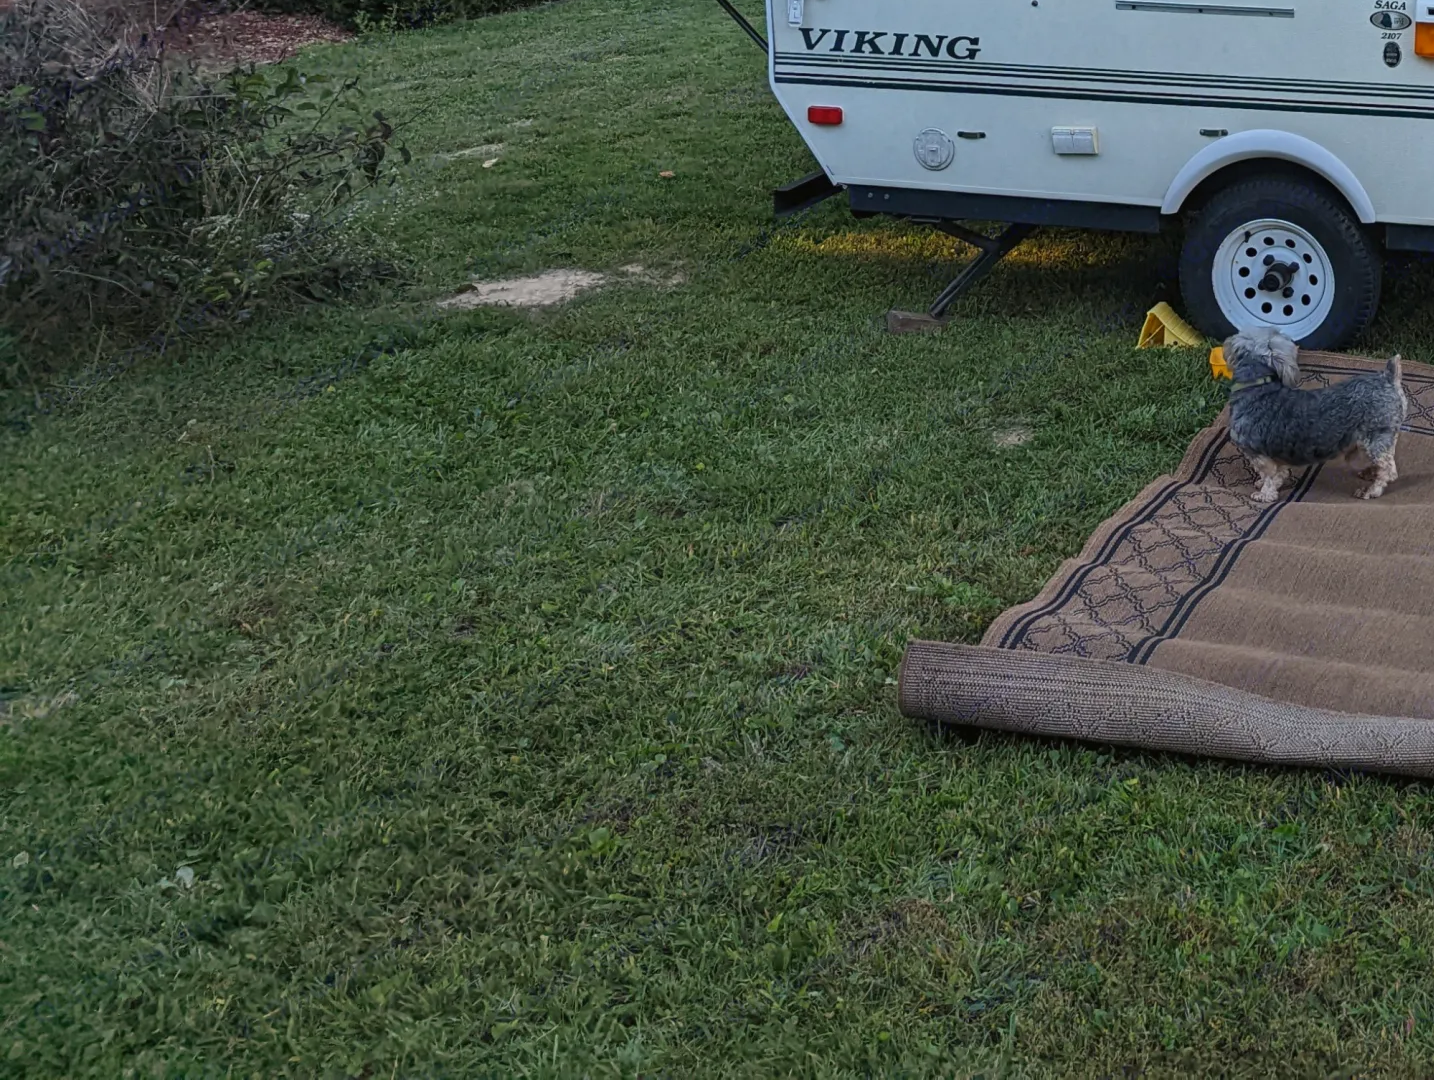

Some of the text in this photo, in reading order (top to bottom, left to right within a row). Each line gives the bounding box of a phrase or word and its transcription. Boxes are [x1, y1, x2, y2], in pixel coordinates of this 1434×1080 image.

[1374, 0, 1406, 11] SAGA
[1381, 32, 1402, 40] 2107
[798, 28, 981, 60] VIKING
